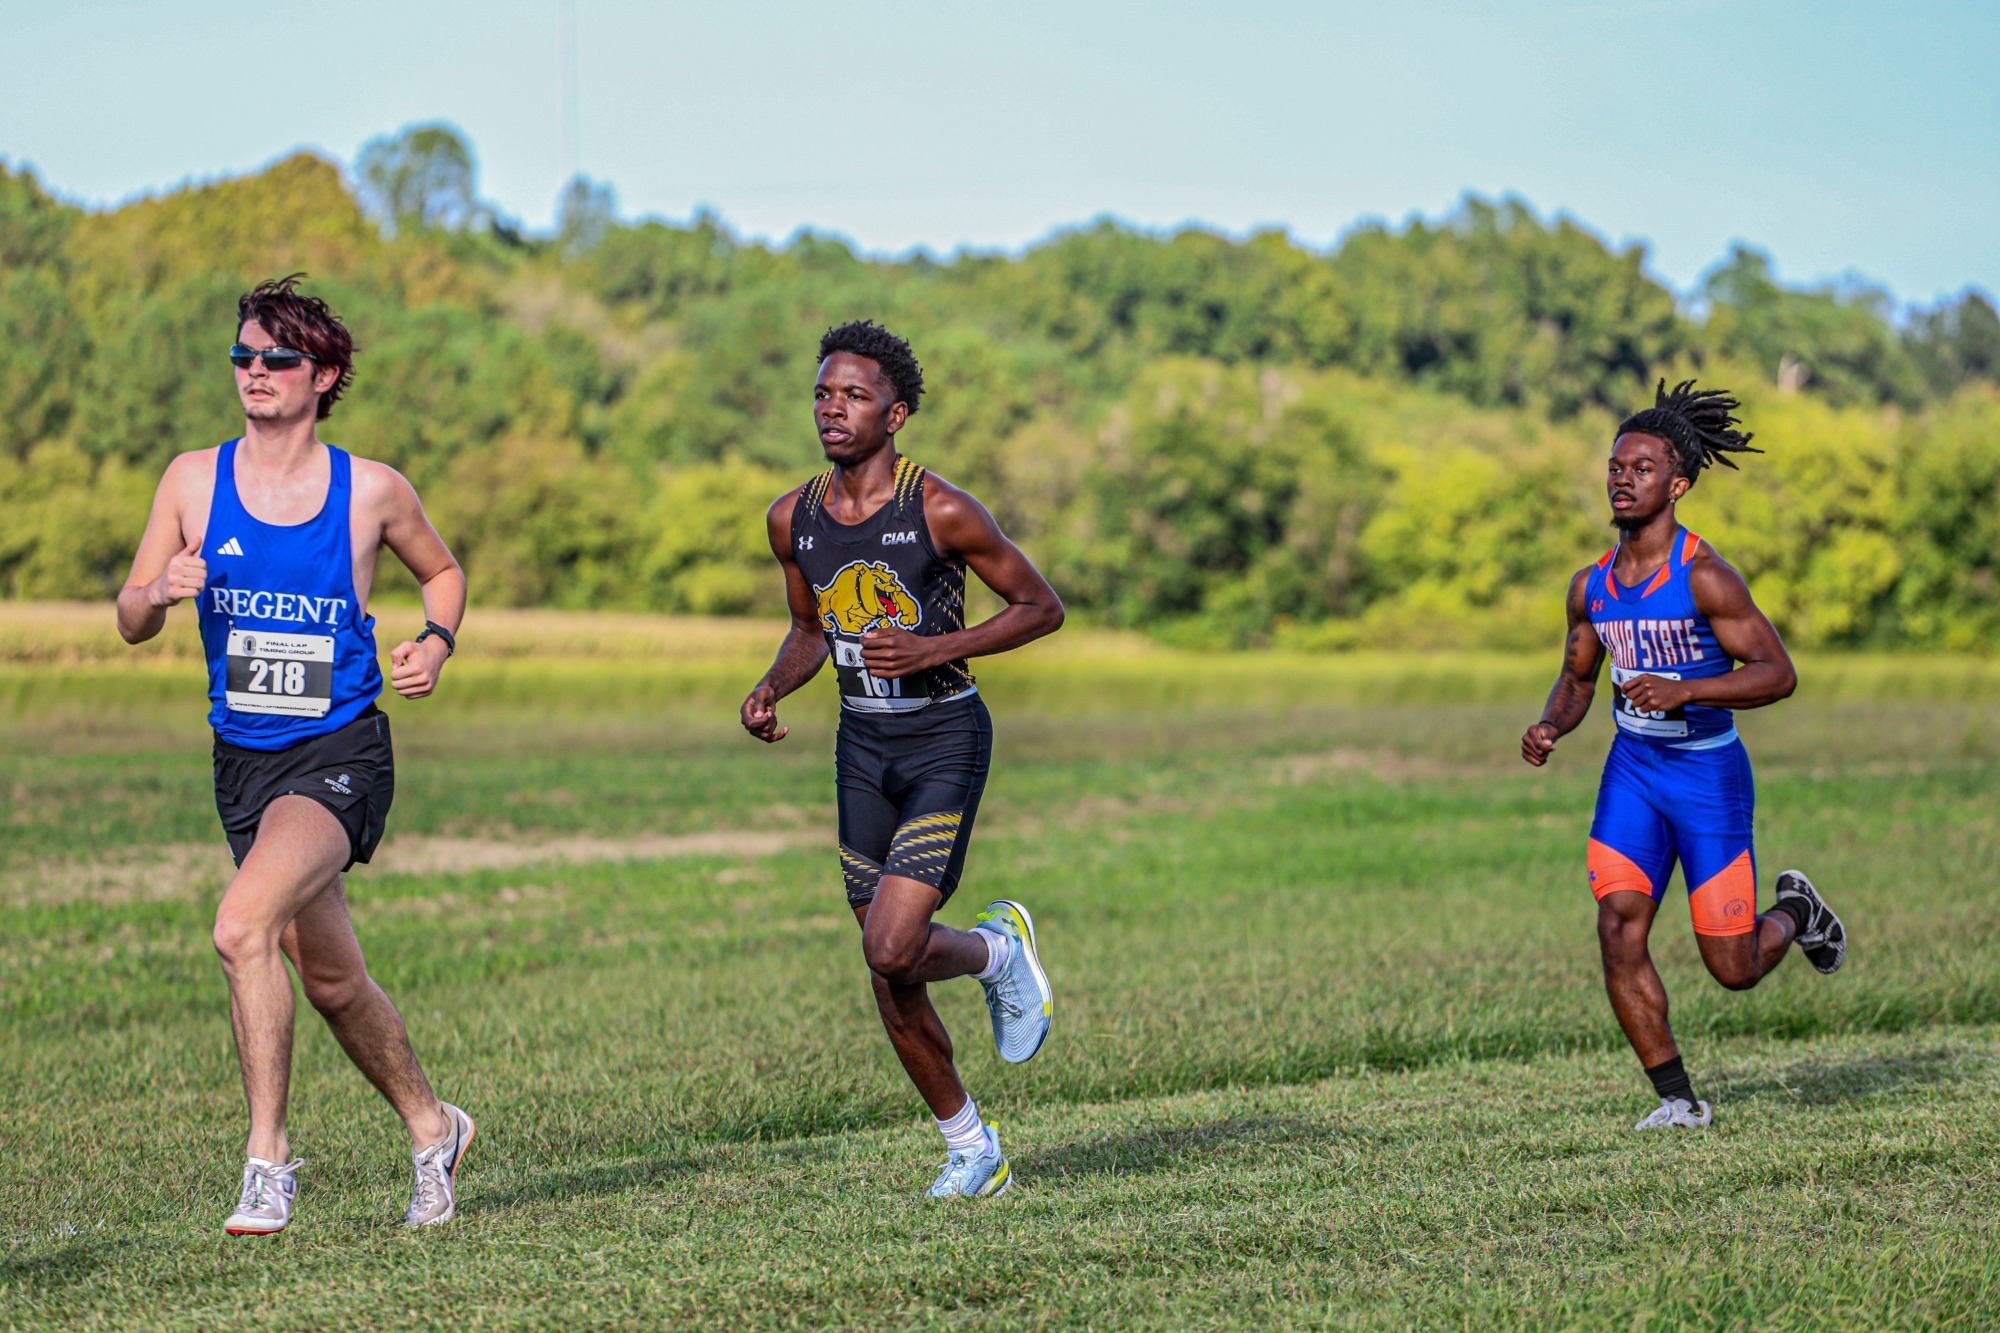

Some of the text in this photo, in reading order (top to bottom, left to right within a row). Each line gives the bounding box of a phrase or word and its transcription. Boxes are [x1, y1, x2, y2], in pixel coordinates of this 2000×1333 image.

[881, 530, 917, 546] CIAA
[210, 587, 347, 625] REGENT
[1638, 619, 1704, 669] STATE
[247, 658, 306, 696] 218
